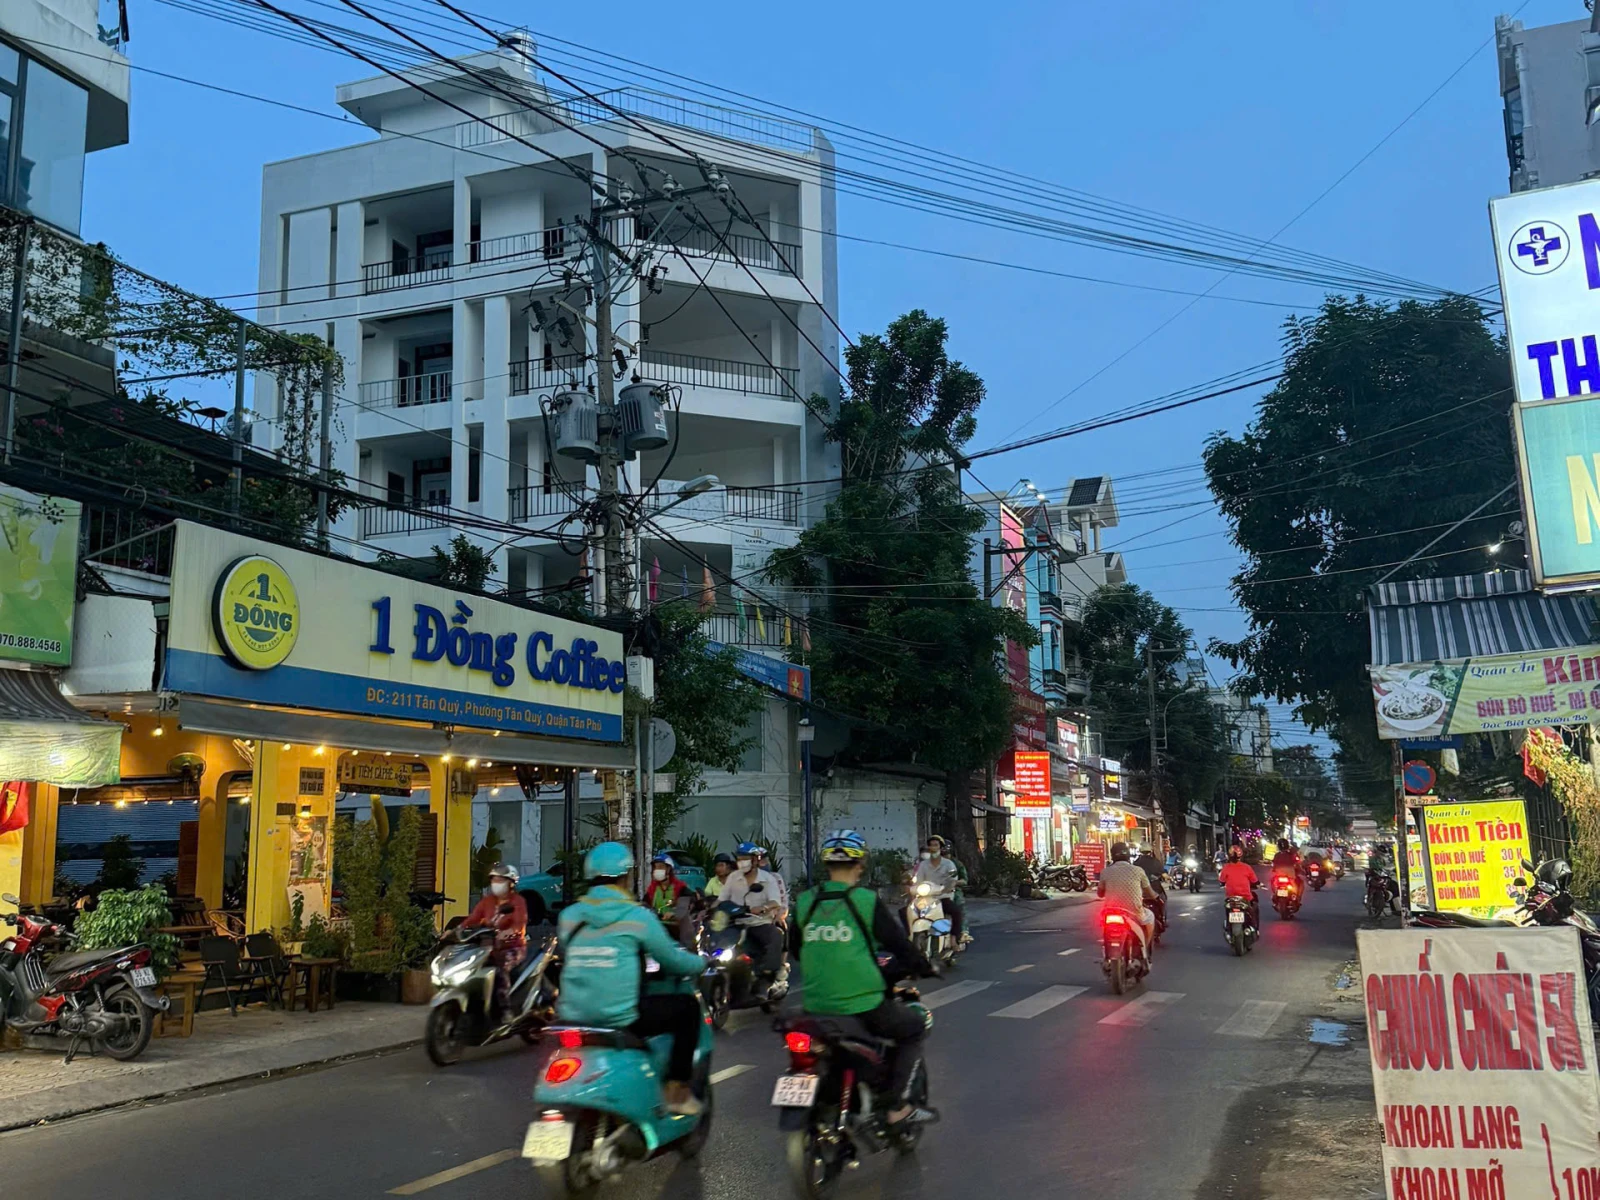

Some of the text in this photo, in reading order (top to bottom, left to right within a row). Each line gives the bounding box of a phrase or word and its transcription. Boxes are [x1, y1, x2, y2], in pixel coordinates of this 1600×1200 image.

[256, 572, 271, 602] 1
[369, 596, 625, 694] 1 Đồng Coffee
[391, 691, 412, 707] 211
[414, 694, 436, 710] Tân
[465, 701, 503, 721] Phường
[504, 706, 522, 721] Tân
[546, 713, 568, 729] Quận
[570, 716, 585, 729] Tân
[1476, 697, 1505, 718] BÚN
[1507, 694, 1527, 716] BÒ
[1529, 688, 1557, 713] HUẾ
[1428, 816, 1523, 844] Kim Tiền
[1433, 850, 1452, 865] BÚN
[1453, 849, 1467, 864] BÒ
[1468, 846, 1487, 863] HUẾ
[1501, 848, 1513, 861] 30
[1435, 868, 1448, 882] MÌ
[1503, 866, 1516, 878] 35
[1437, 885, 1456, 900] BÚN
[1458, 882, 1480, 899] MẮM
[803, 920, 853, 942] Grab
[1366, 938, 1454, 1072] CHUỐI
[1539, 972, 1588, 1072] 5K
[1383, 1104, 1523, 1150] KHOAI LANG
[1390, 1166, 1461, 1200] KHOAI
